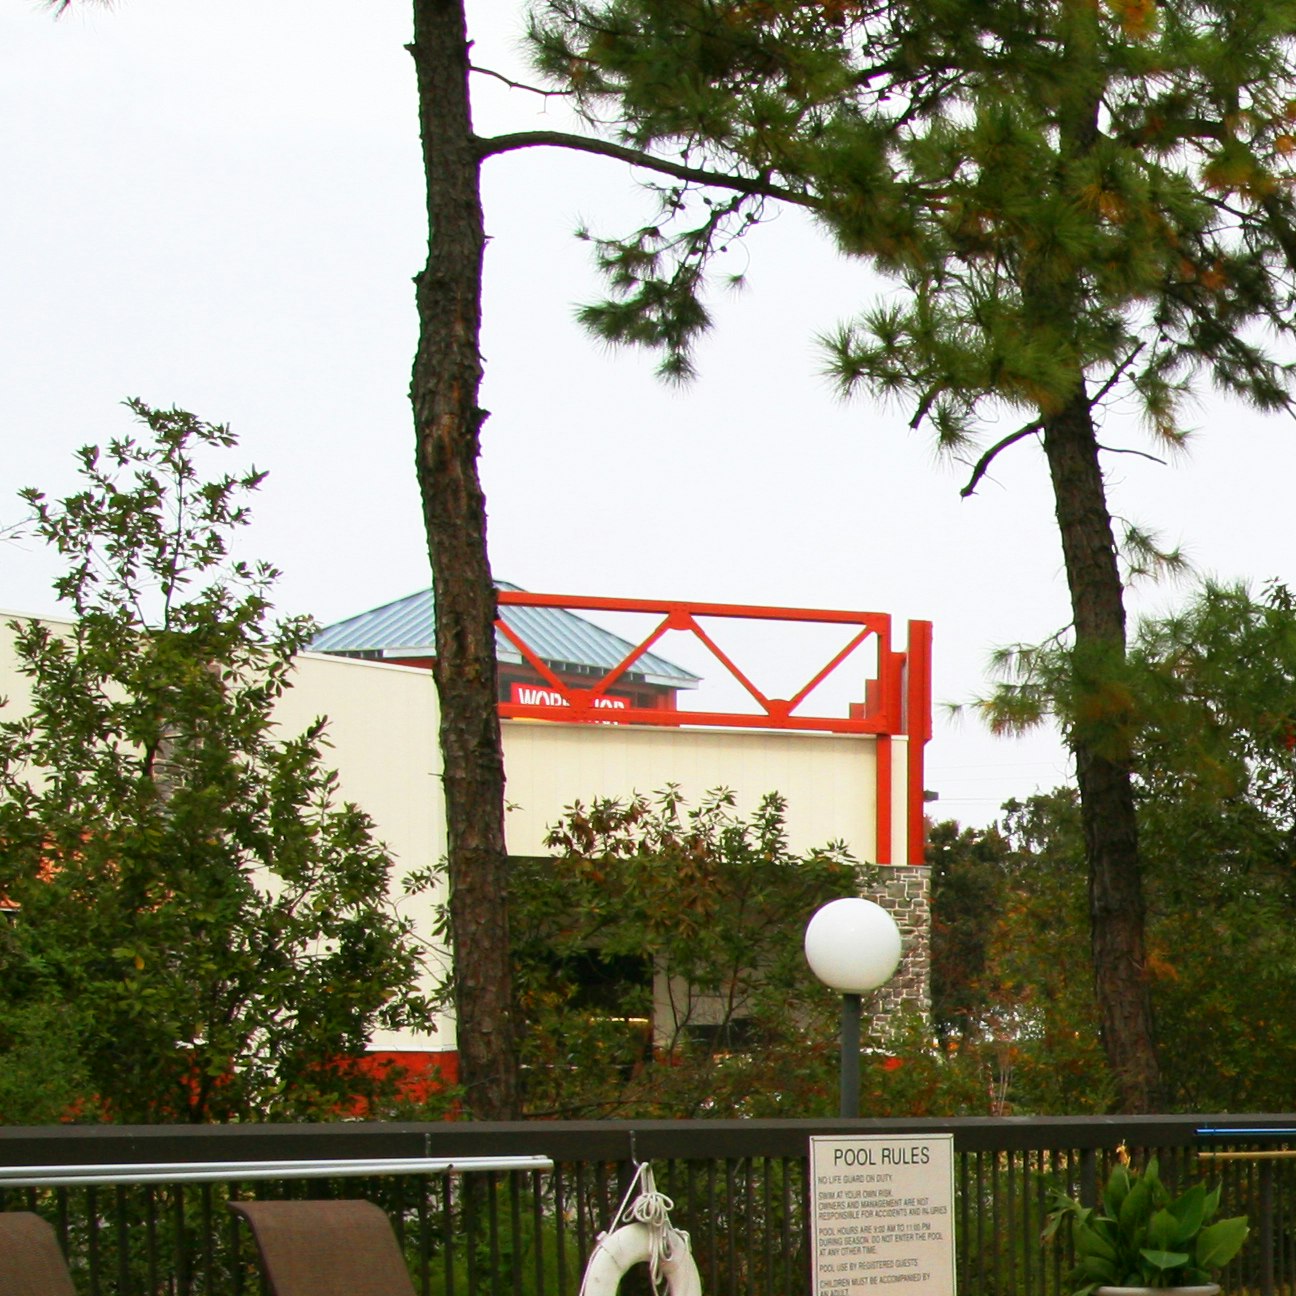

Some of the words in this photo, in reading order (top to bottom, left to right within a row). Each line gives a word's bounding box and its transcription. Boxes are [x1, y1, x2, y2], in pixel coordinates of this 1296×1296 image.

[834, 1148, 876, 1166] POOL
[882, 1147, 930, 1165] RULES
[818, 1176, 828, 1184] NO
[843, 1174, 864, 1183] GUARD
[866, 1174, 875, 1182] ON
